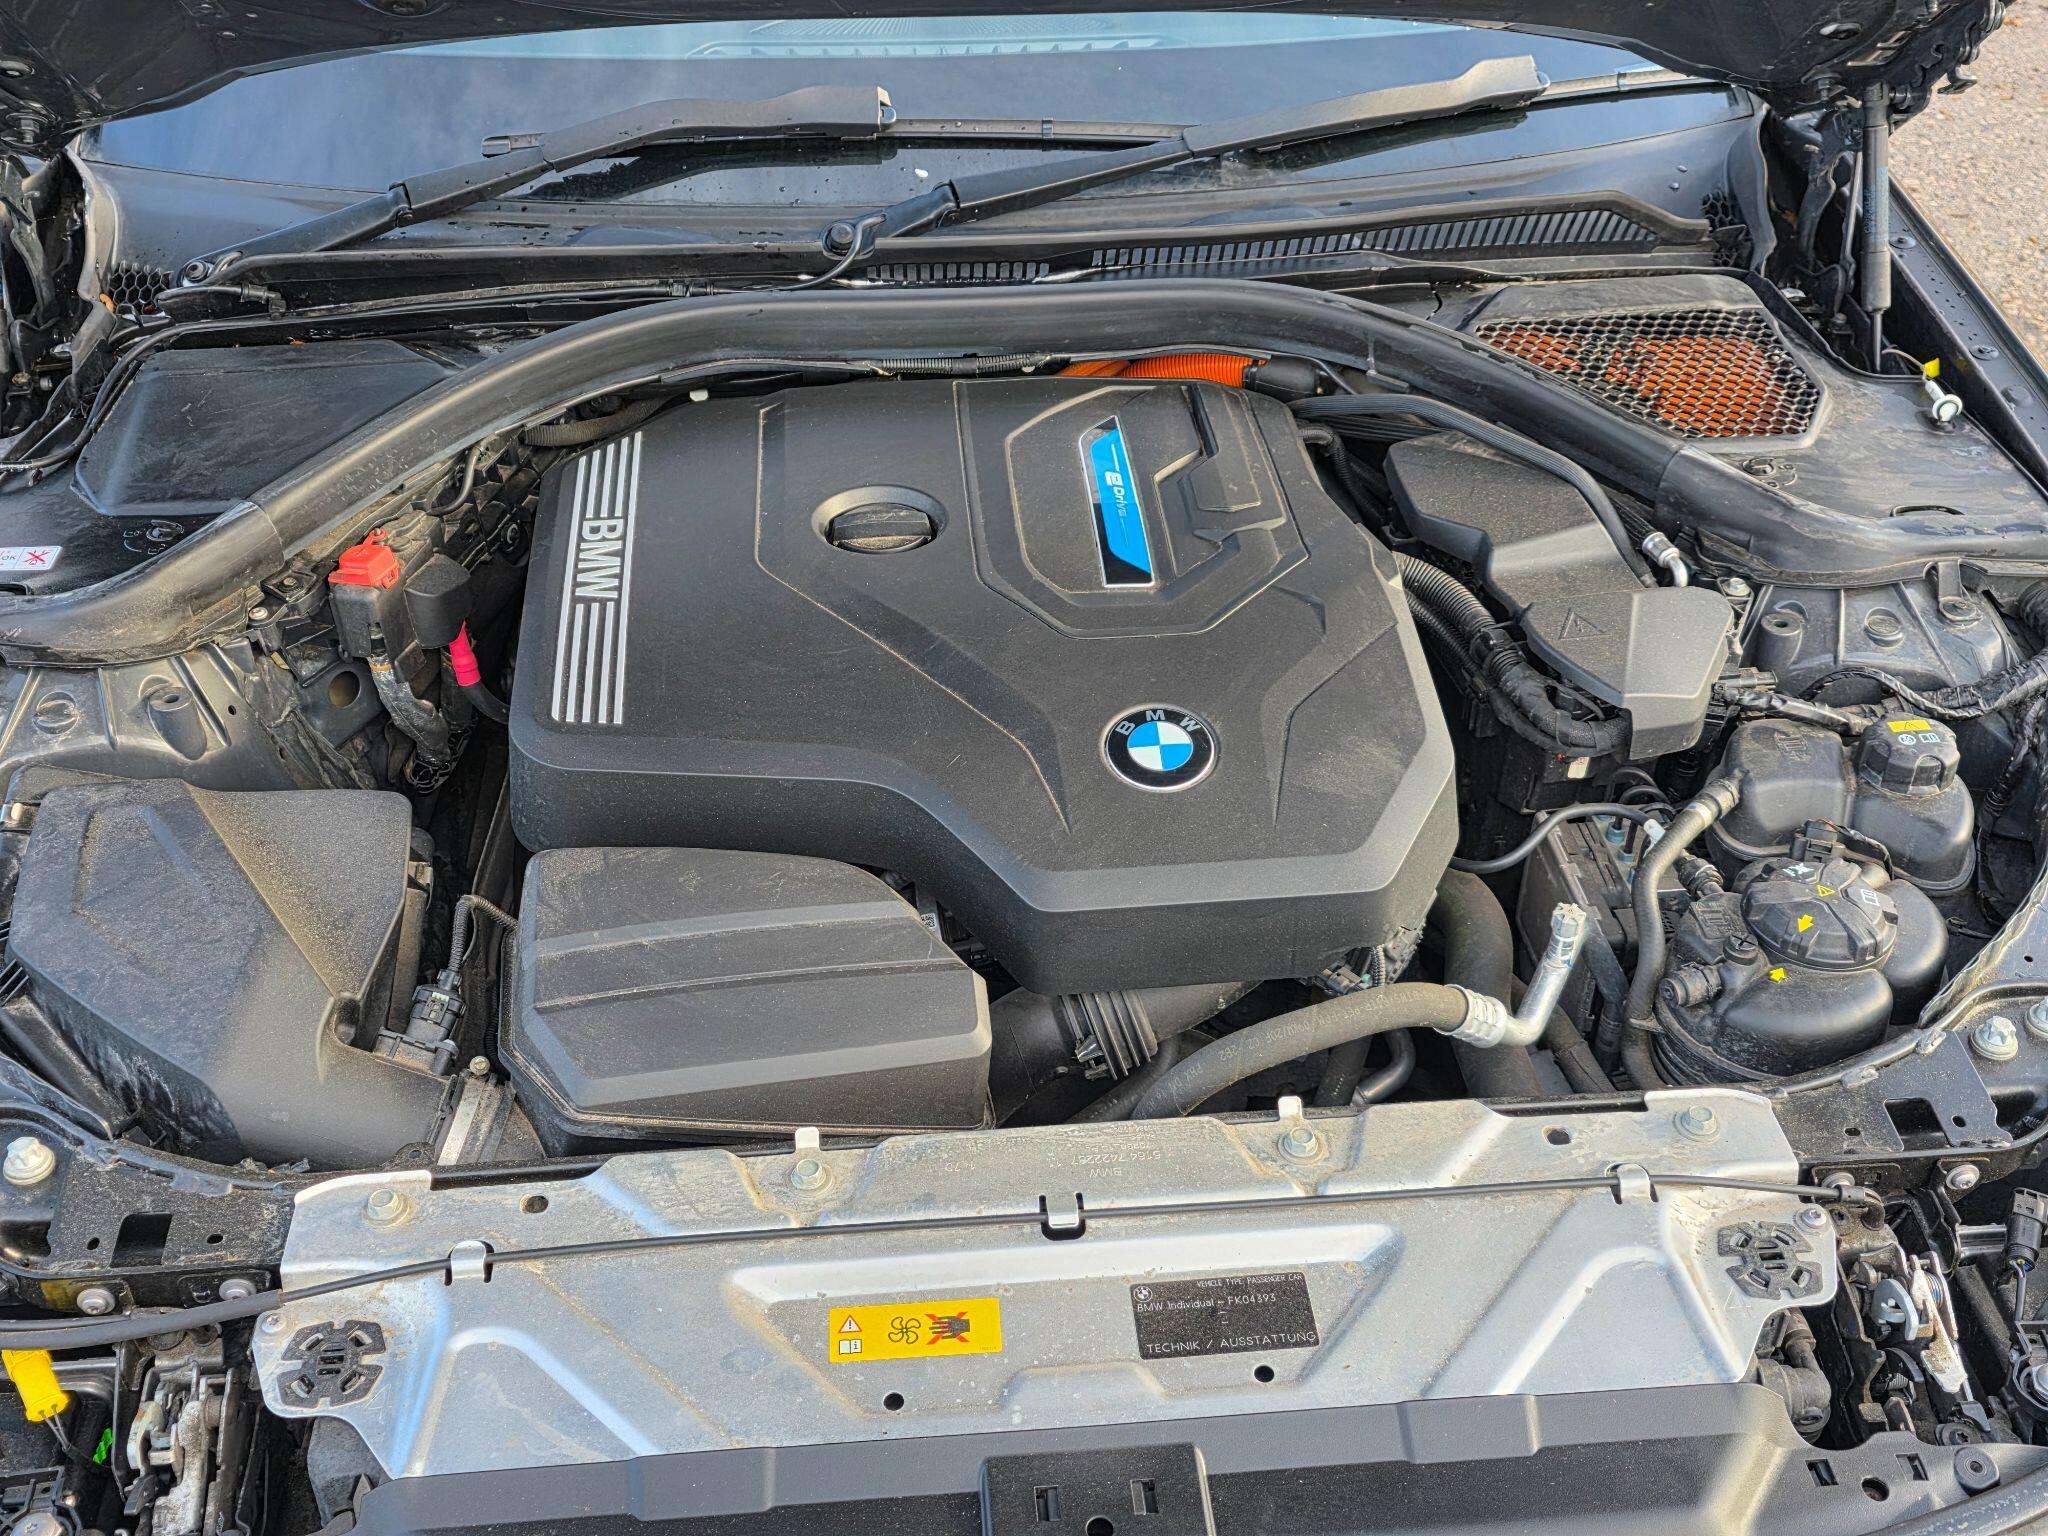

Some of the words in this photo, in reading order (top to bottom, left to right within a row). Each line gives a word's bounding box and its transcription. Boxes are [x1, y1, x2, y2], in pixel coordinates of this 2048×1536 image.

[575, 518, 624, 599] BMW
[1115, 709, 1201, 736] BMW
[1137, 1301, 1163, 1312] BMW
[1167, 1298, 1214, 1311] Individual
[1147, 1340, 1201, 1353] TECHNIK
[1220, 1331, 1317, 1349] AUSSTATTUNG
